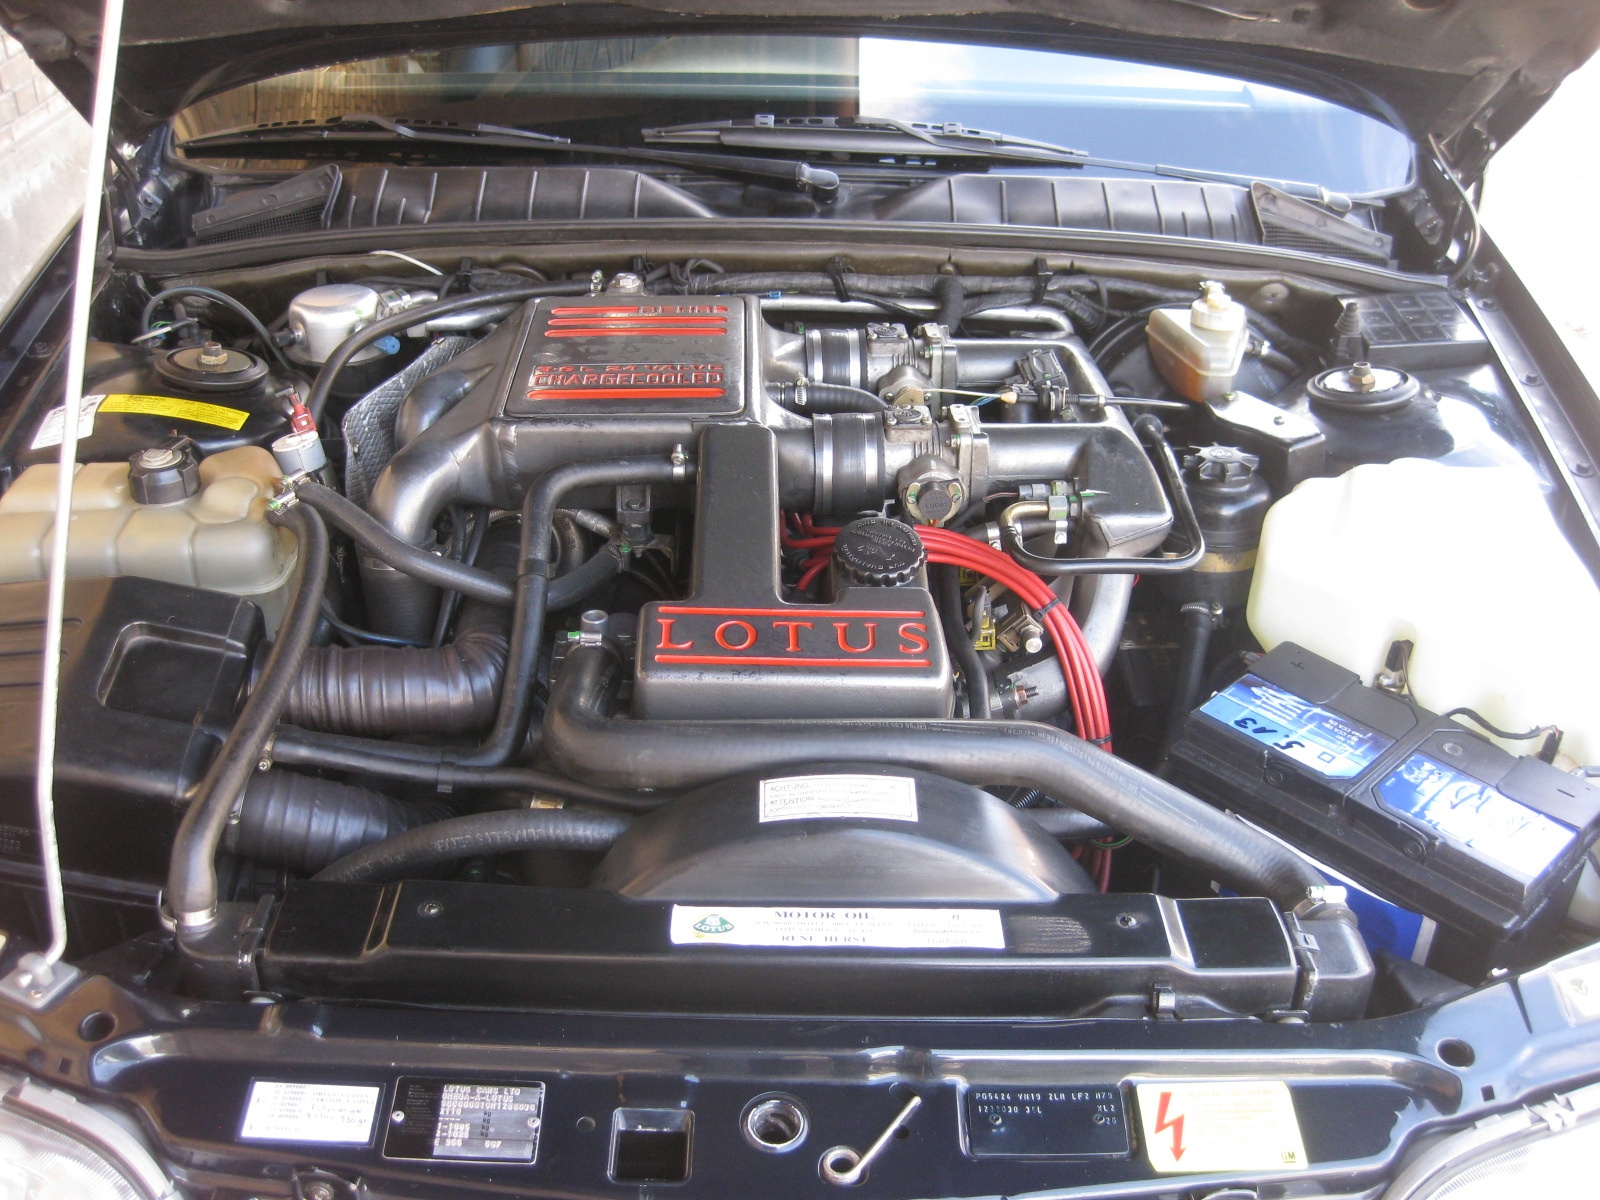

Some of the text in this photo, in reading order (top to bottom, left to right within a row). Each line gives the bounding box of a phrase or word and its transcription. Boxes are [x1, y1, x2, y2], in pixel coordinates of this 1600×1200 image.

[644, 363, 724, 371] VALVE
[533, 372, 724, 386] CHARGECOOLED
[655, 618, 931, 654] LOTUS
[774, 910, 836, 920] MOTOR
[844, 911, 875, 920] OIL
[694, 922, 733, 933] LOTUS
[443, 1084, 522, 1096] LOTUS CARS LTD
[441, 1092, 515, 1103] OMEGA-A-LOTUS
[483, 1110, 492, 1118] kg
[481, 1123, 490, 1131] kg
[480, 1130, 489, 1138] kg
[1280, 1150, 1297, 1161] GM
